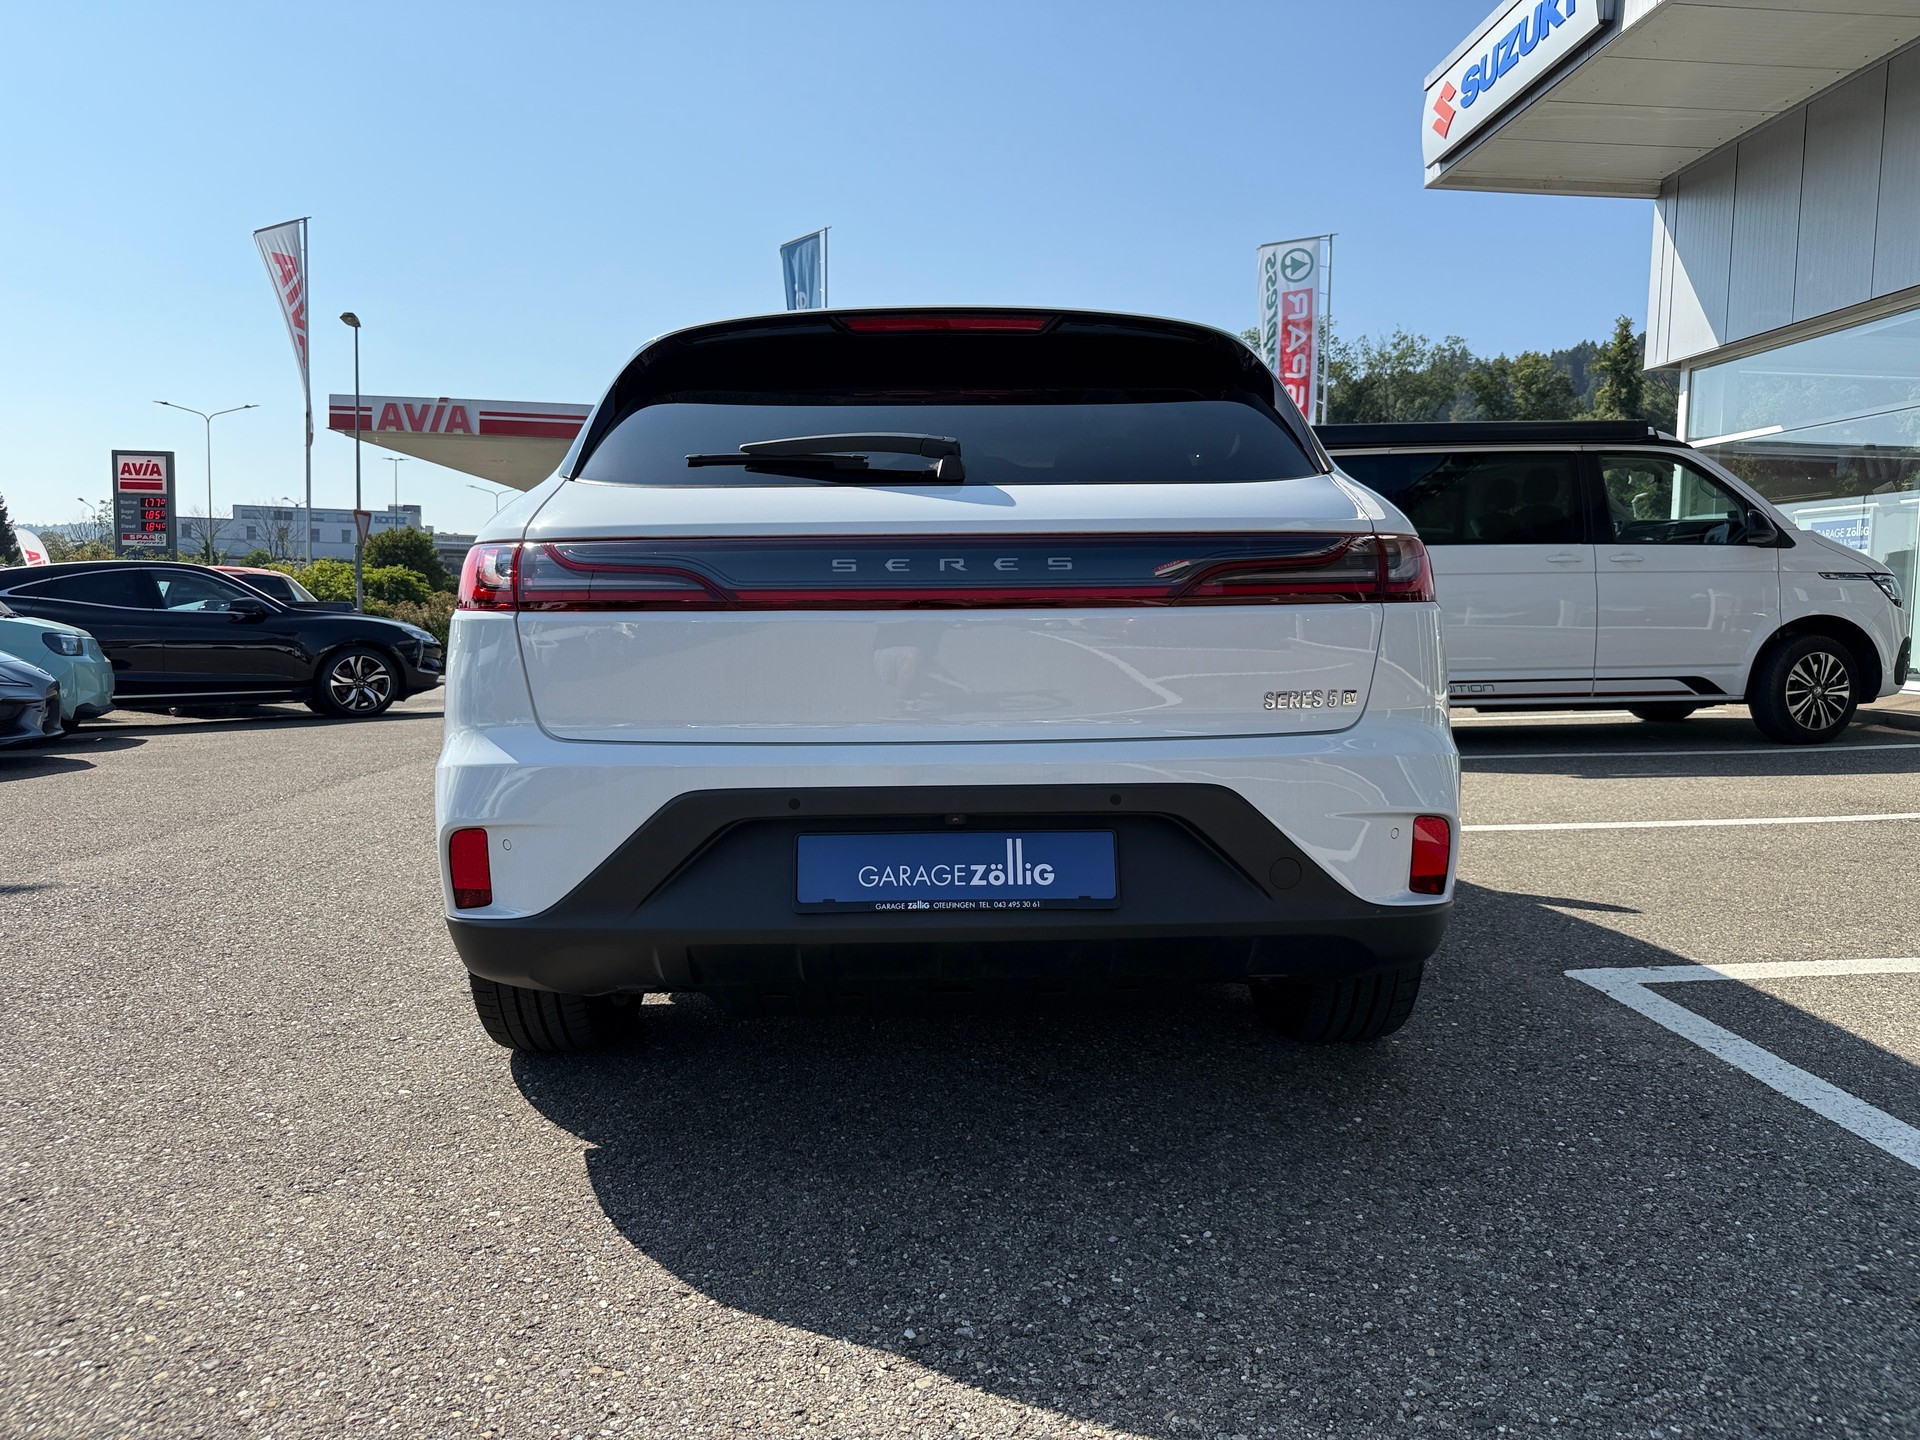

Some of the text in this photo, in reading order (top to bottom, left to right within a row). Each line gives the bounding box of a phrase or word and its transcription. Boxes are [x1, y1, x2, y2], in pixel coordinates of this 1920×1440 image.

[831, 556, 1073, 573] SERES
[1263, 687, 1357, 710] SERES 5 EV
[858, 863, 967, 888] GARAGE
[875, 902, 905, 910] GARAGE
[933, 901, 976, 909] OTELFINGEN
[979, 901, 991, 909] TEL.
[993, 901, 1007, 909] 043
[1032, 900, 1041, 908] 61
